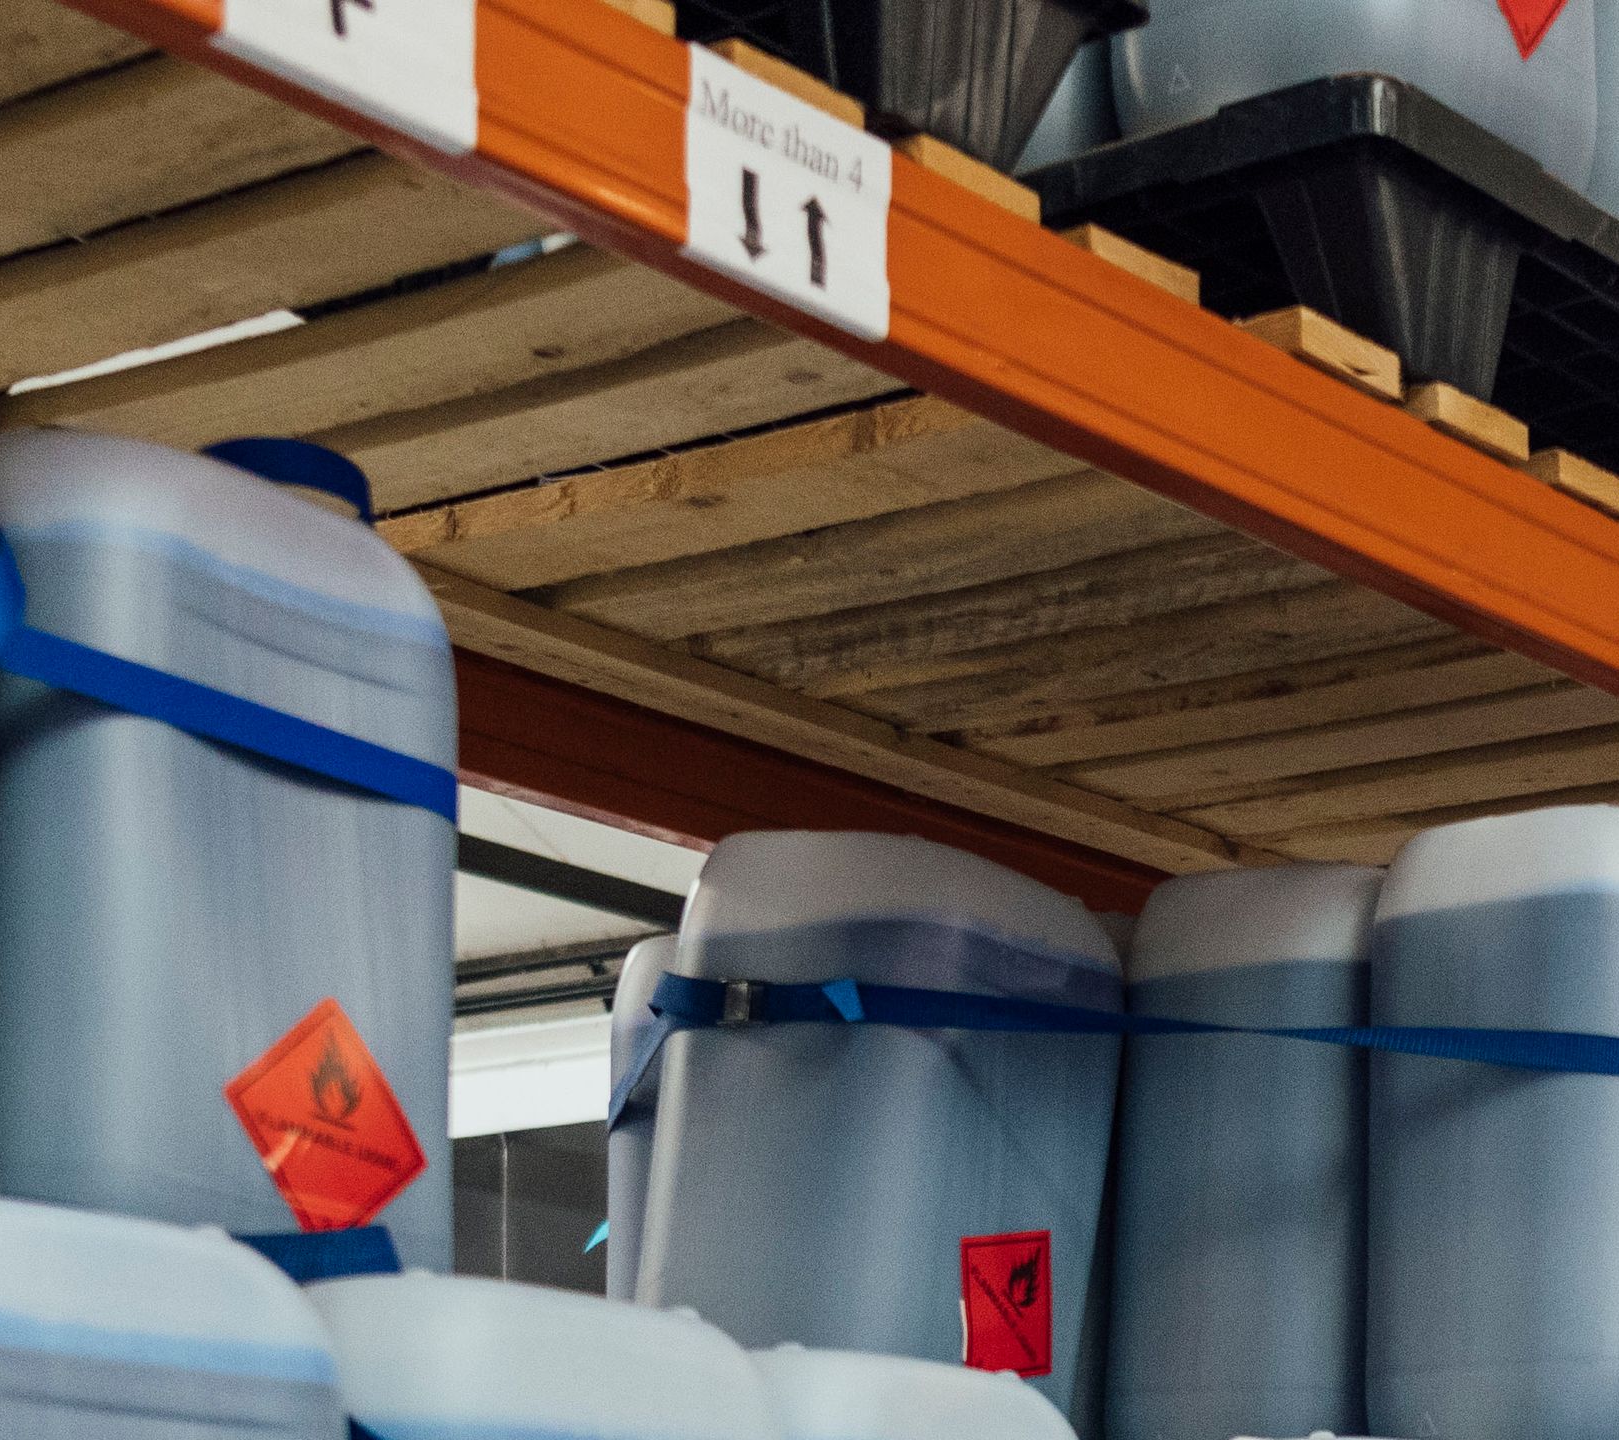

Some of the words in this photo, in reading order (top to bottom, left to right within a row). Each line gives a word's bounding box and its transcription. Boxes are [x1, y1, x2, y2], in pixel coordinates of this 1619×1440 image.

[699, 78, 775, 151] More
[781, 124, 839, 181] than
[848, 156, 864, 193] 4
